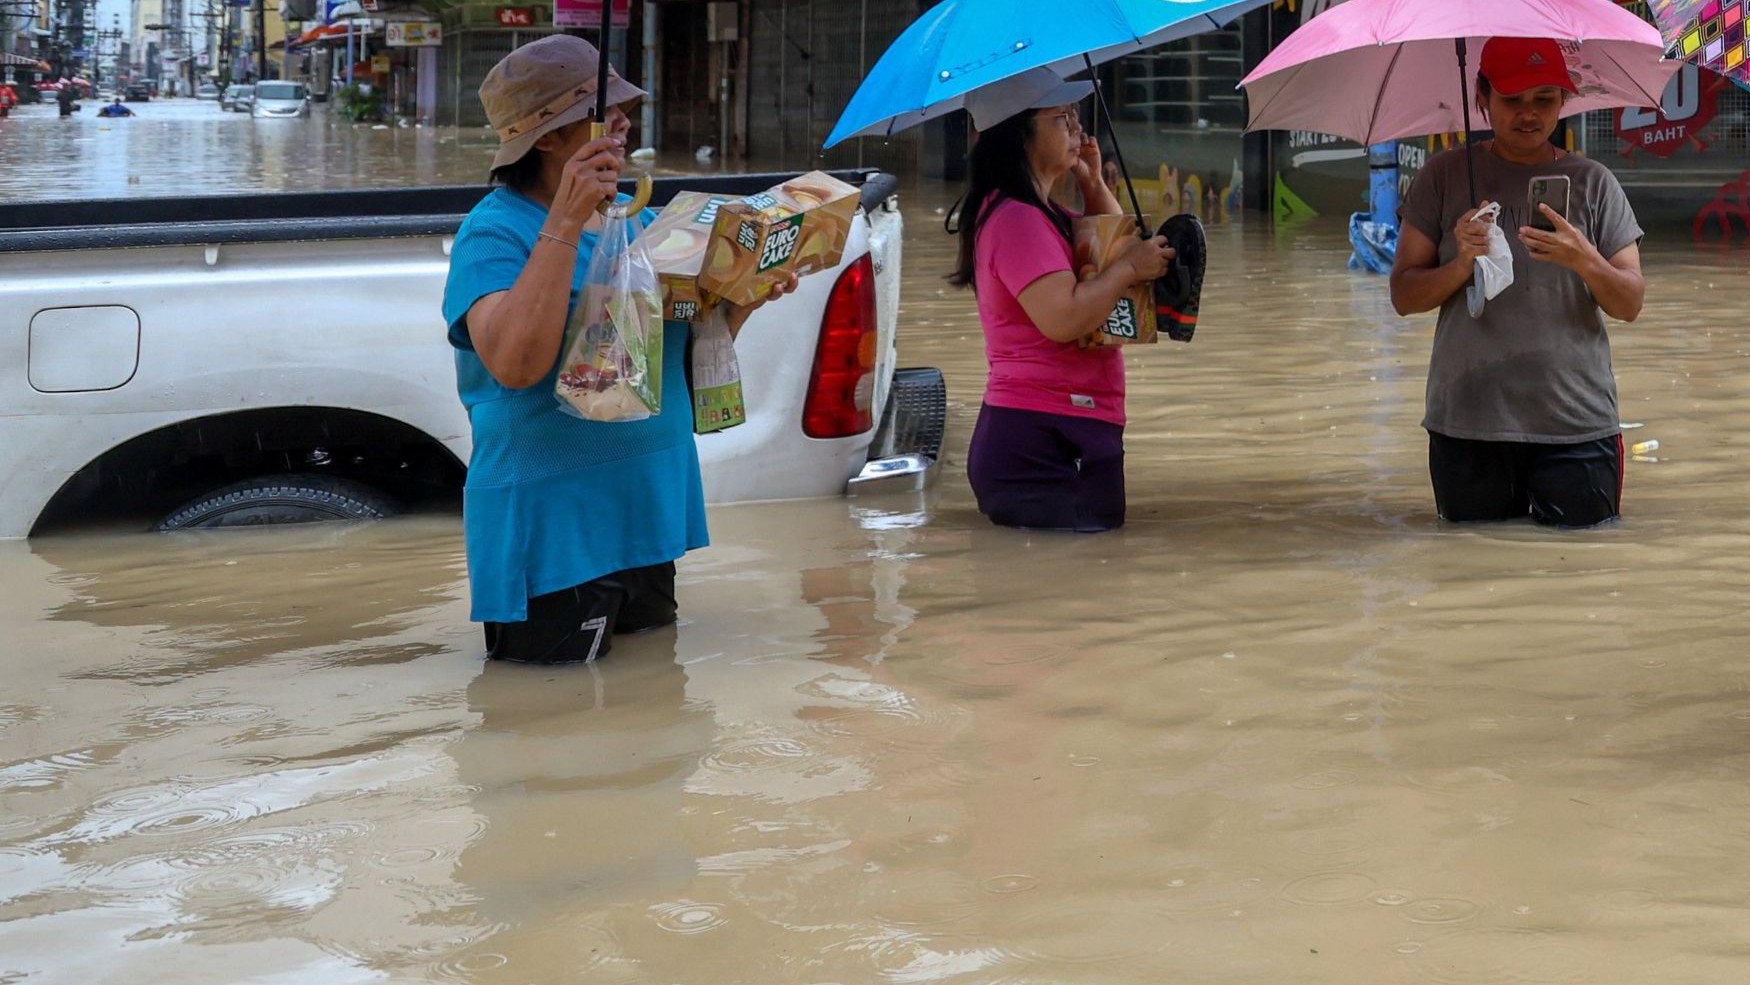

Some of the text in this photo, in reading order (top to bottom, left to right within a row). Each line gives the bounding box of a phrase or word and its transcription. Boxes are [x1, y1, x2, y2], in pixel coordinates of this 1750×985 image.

[1643, 125, 1687, 145] BAHT
[1398, 143, 1426, 170] OPEN
[764, 225, 800, 256] EURO
[760, 243, 796, 270] CAKE
[1118, 299, 1134, 337] CAKE
[581, 615, 608, 664] 7
